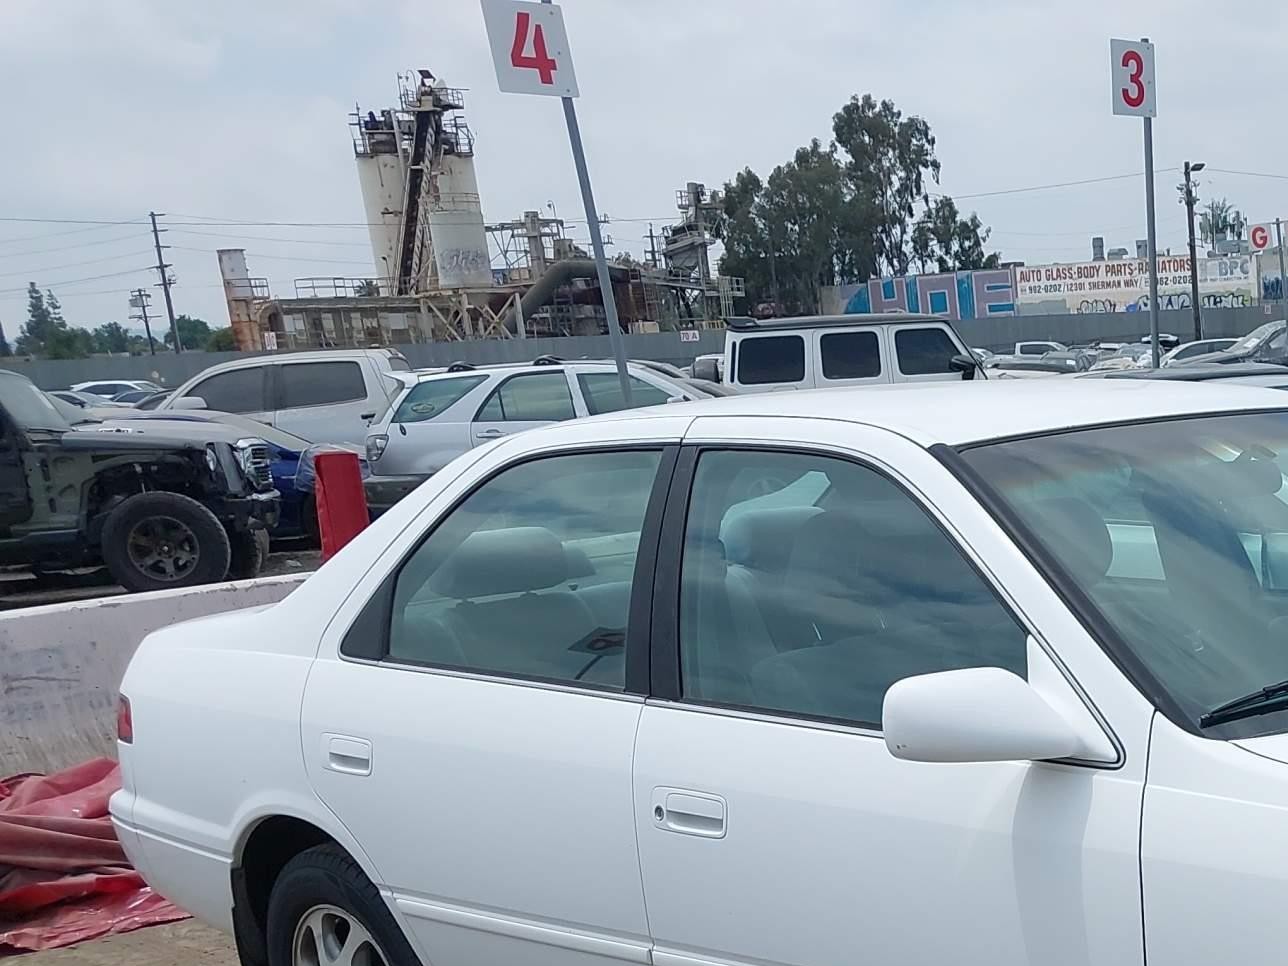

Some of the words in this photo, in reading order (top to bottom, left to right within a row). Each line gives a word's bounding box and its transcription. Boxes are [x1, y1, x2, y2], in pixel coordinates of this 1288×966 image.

[511, 13, 557, 85] 4
[1121, 51, 1145, 107] 3
[1251, 226, 1268, 249] G
[1020, 269, 1042, 283] AUTO
[1088, 280, 1122, 291] SHERMAN
